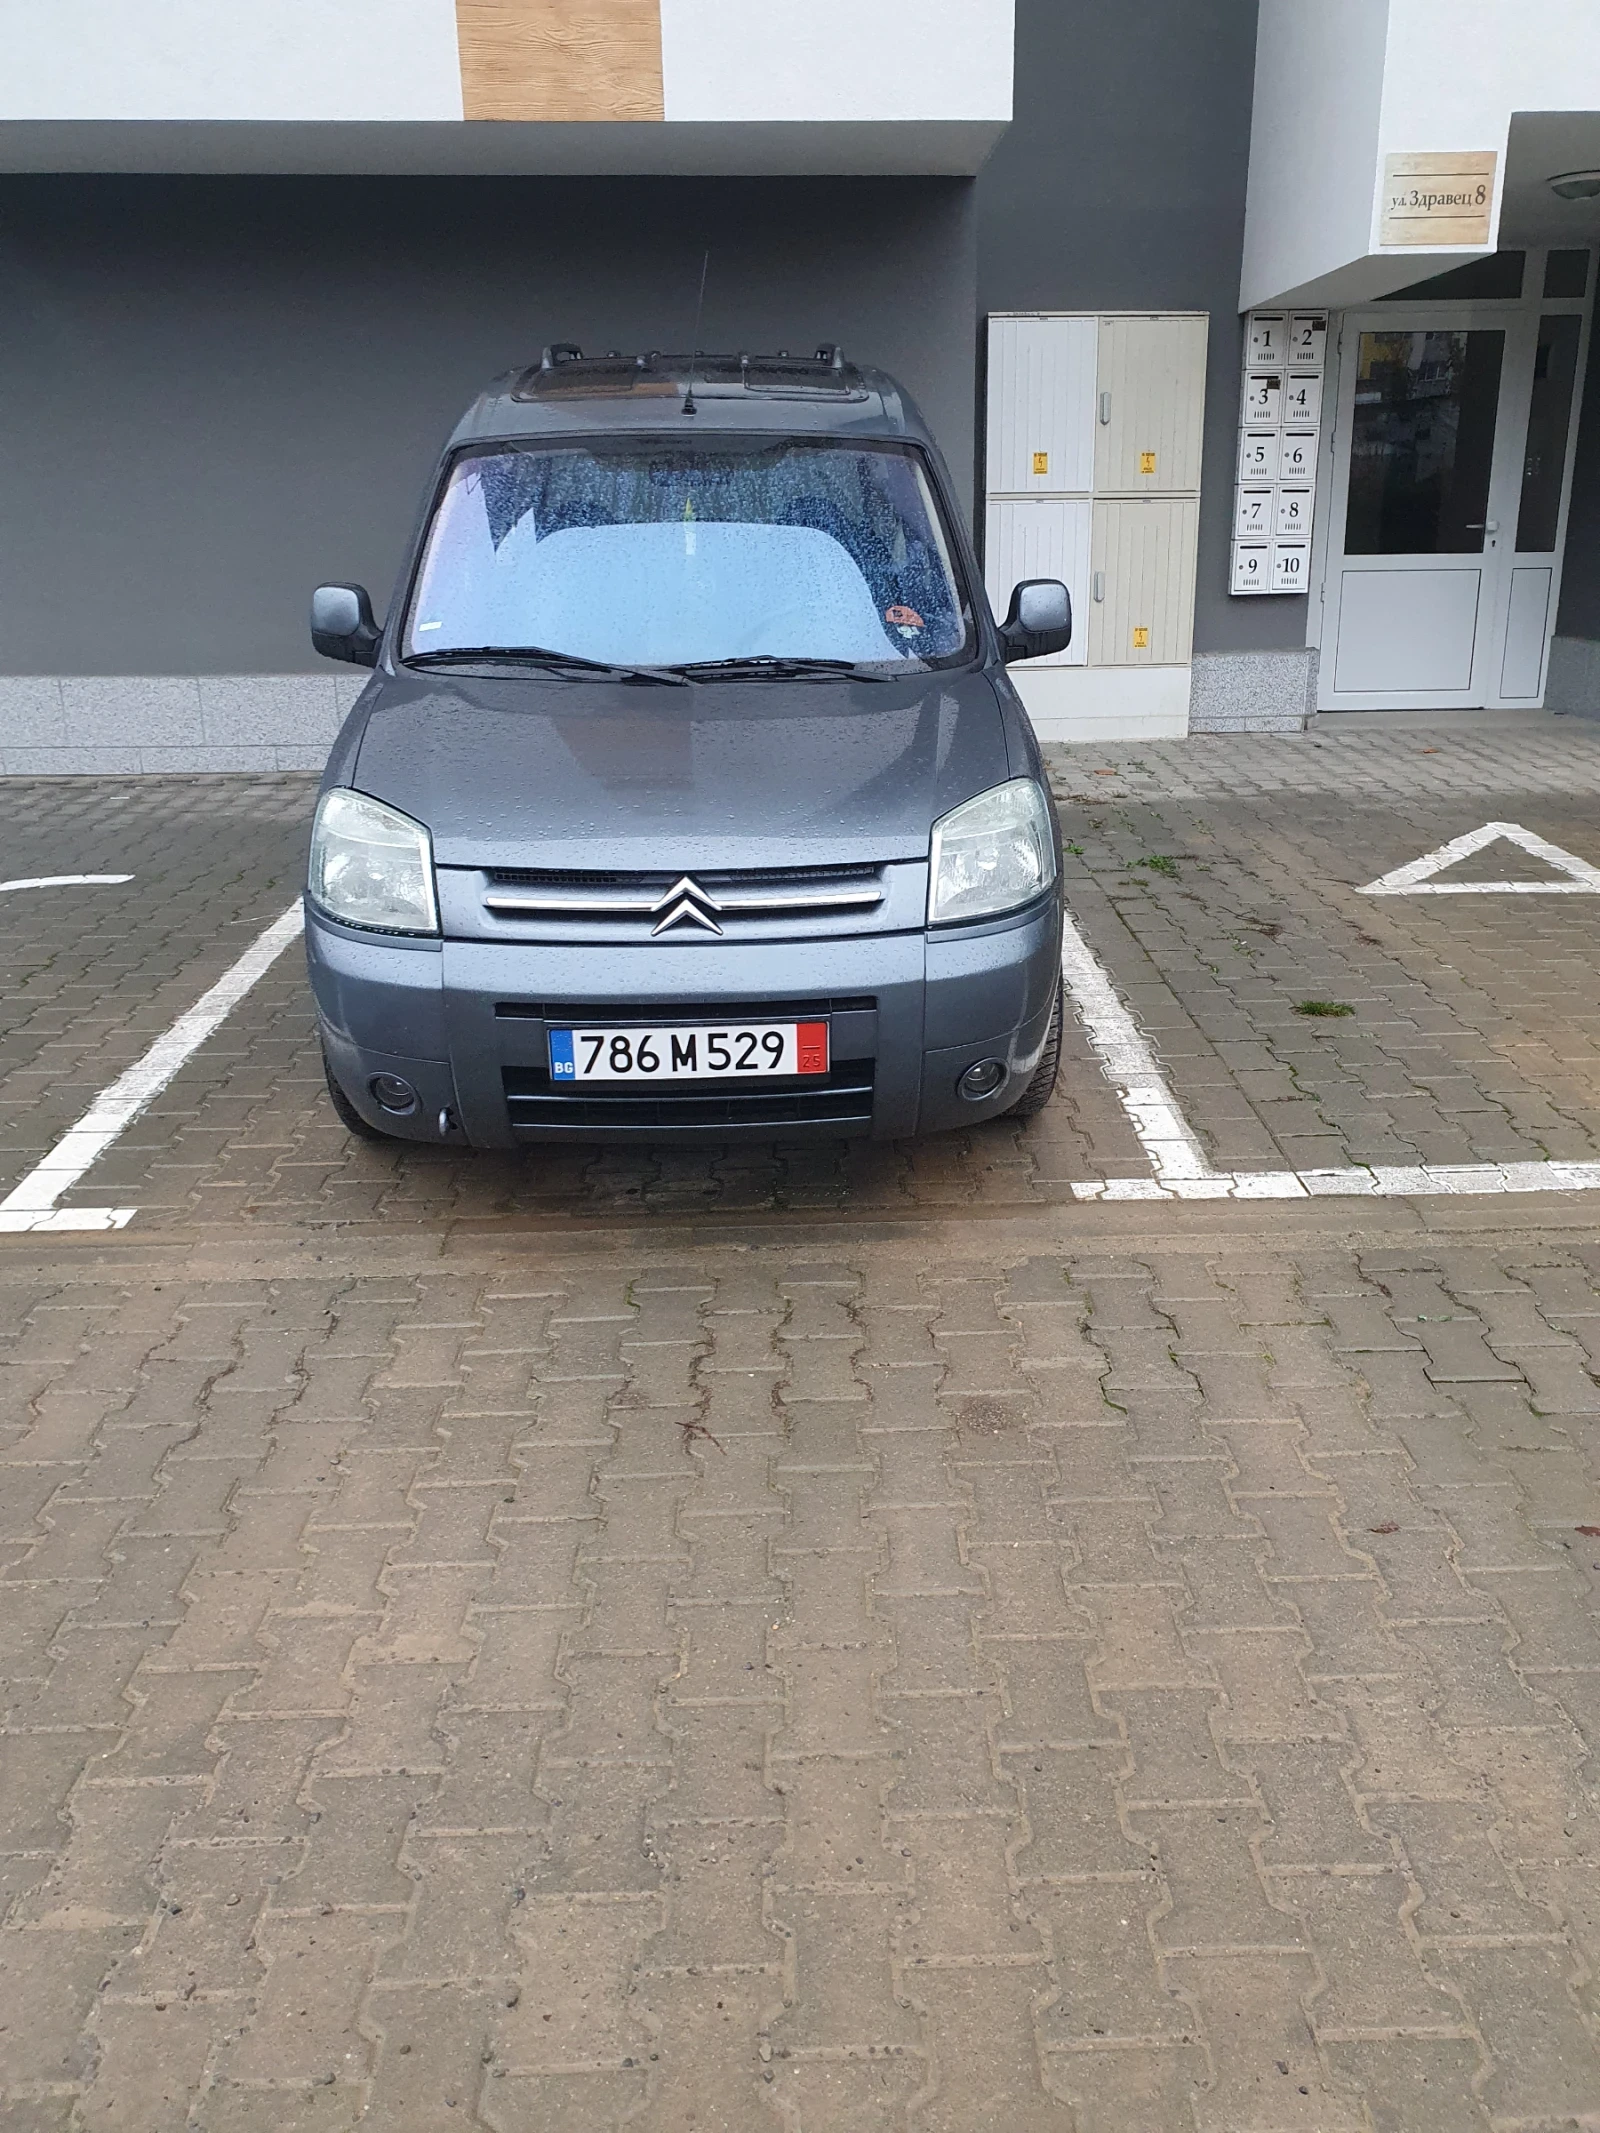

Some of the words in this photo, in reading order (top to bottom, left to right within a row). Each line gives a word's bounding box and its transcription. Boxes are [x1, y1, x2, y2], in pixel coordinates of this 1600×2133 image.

[1391, 197, 1407, 210] ул.
[1410, 190, 1472, 211] Здравец
[1475, 184, 1486, 205] 8
[1263, 330, 1271, 347] 1
[1301, 329, 1312, 346] 2
[1259, 388, 1269, 405] 3
[1296, 388, 1306, 405] 4
[1255, 446, 1265, 462] 5
[1293, 447, 1303, 463] 6
[1251, 503, 1262, 519] 7
[1289, 502, 1299, 518] 8
[1248, 558, 1258, 575] 9
[1281, 557, 1300, 573] 10
[554, 1061, 574, 1074] BG
[802, 1053, 821, 1068] 25
